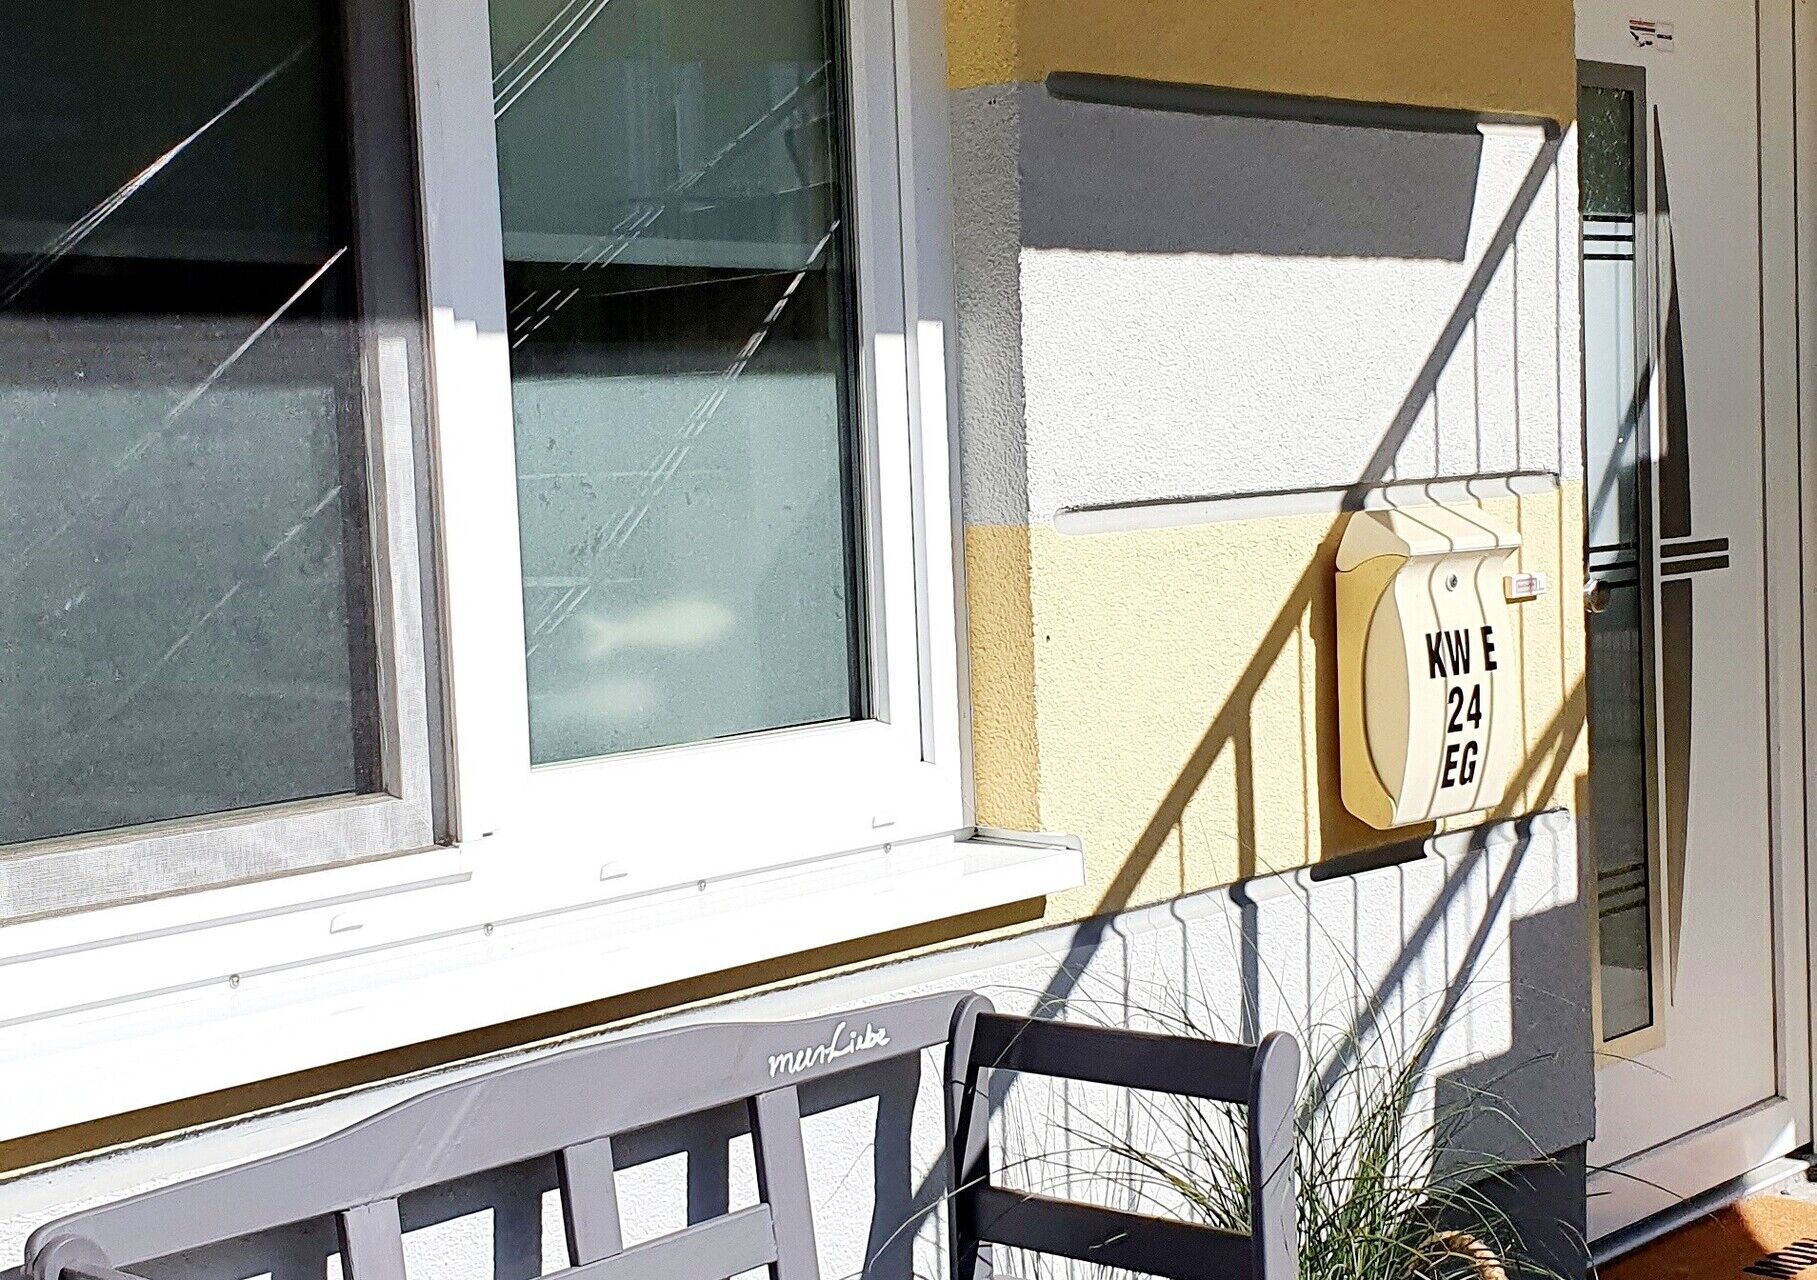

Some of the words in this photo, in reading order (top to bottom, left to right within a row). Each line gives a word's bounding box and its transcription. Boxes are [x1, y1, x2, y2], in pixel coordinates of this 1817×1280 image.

[1425, 628, 1470, 679] KW
[1447, 684, 1482, 733] 24
[1440, 740, 1478, 789] EG
